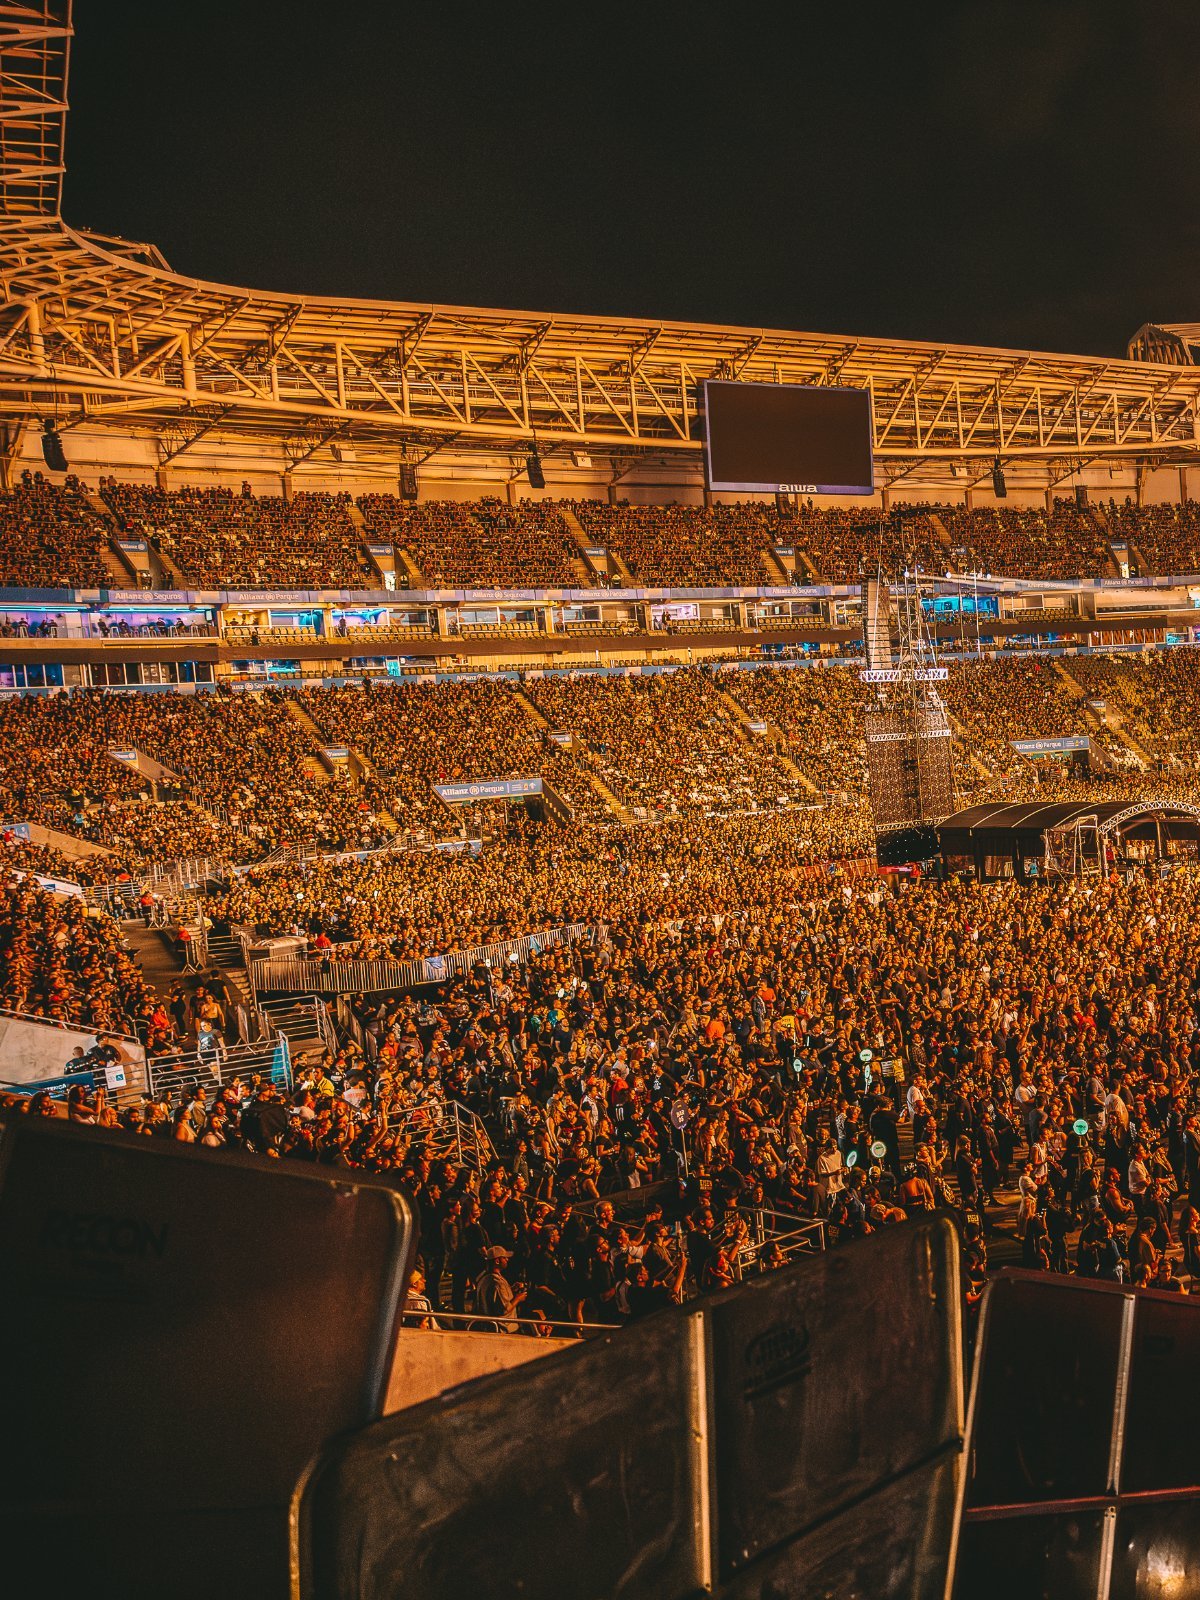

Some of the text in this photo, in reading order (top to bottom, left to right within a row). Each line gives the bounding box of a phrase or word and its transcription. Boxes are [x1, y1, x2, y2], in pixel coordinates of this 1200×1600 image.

[779, 484, 818, 493] aiwa
[115, 592, 183, 600] Allianz Seguros
[442, 788, 468, 796] Allianz
[38, 1209, 168, 1259] RECON
